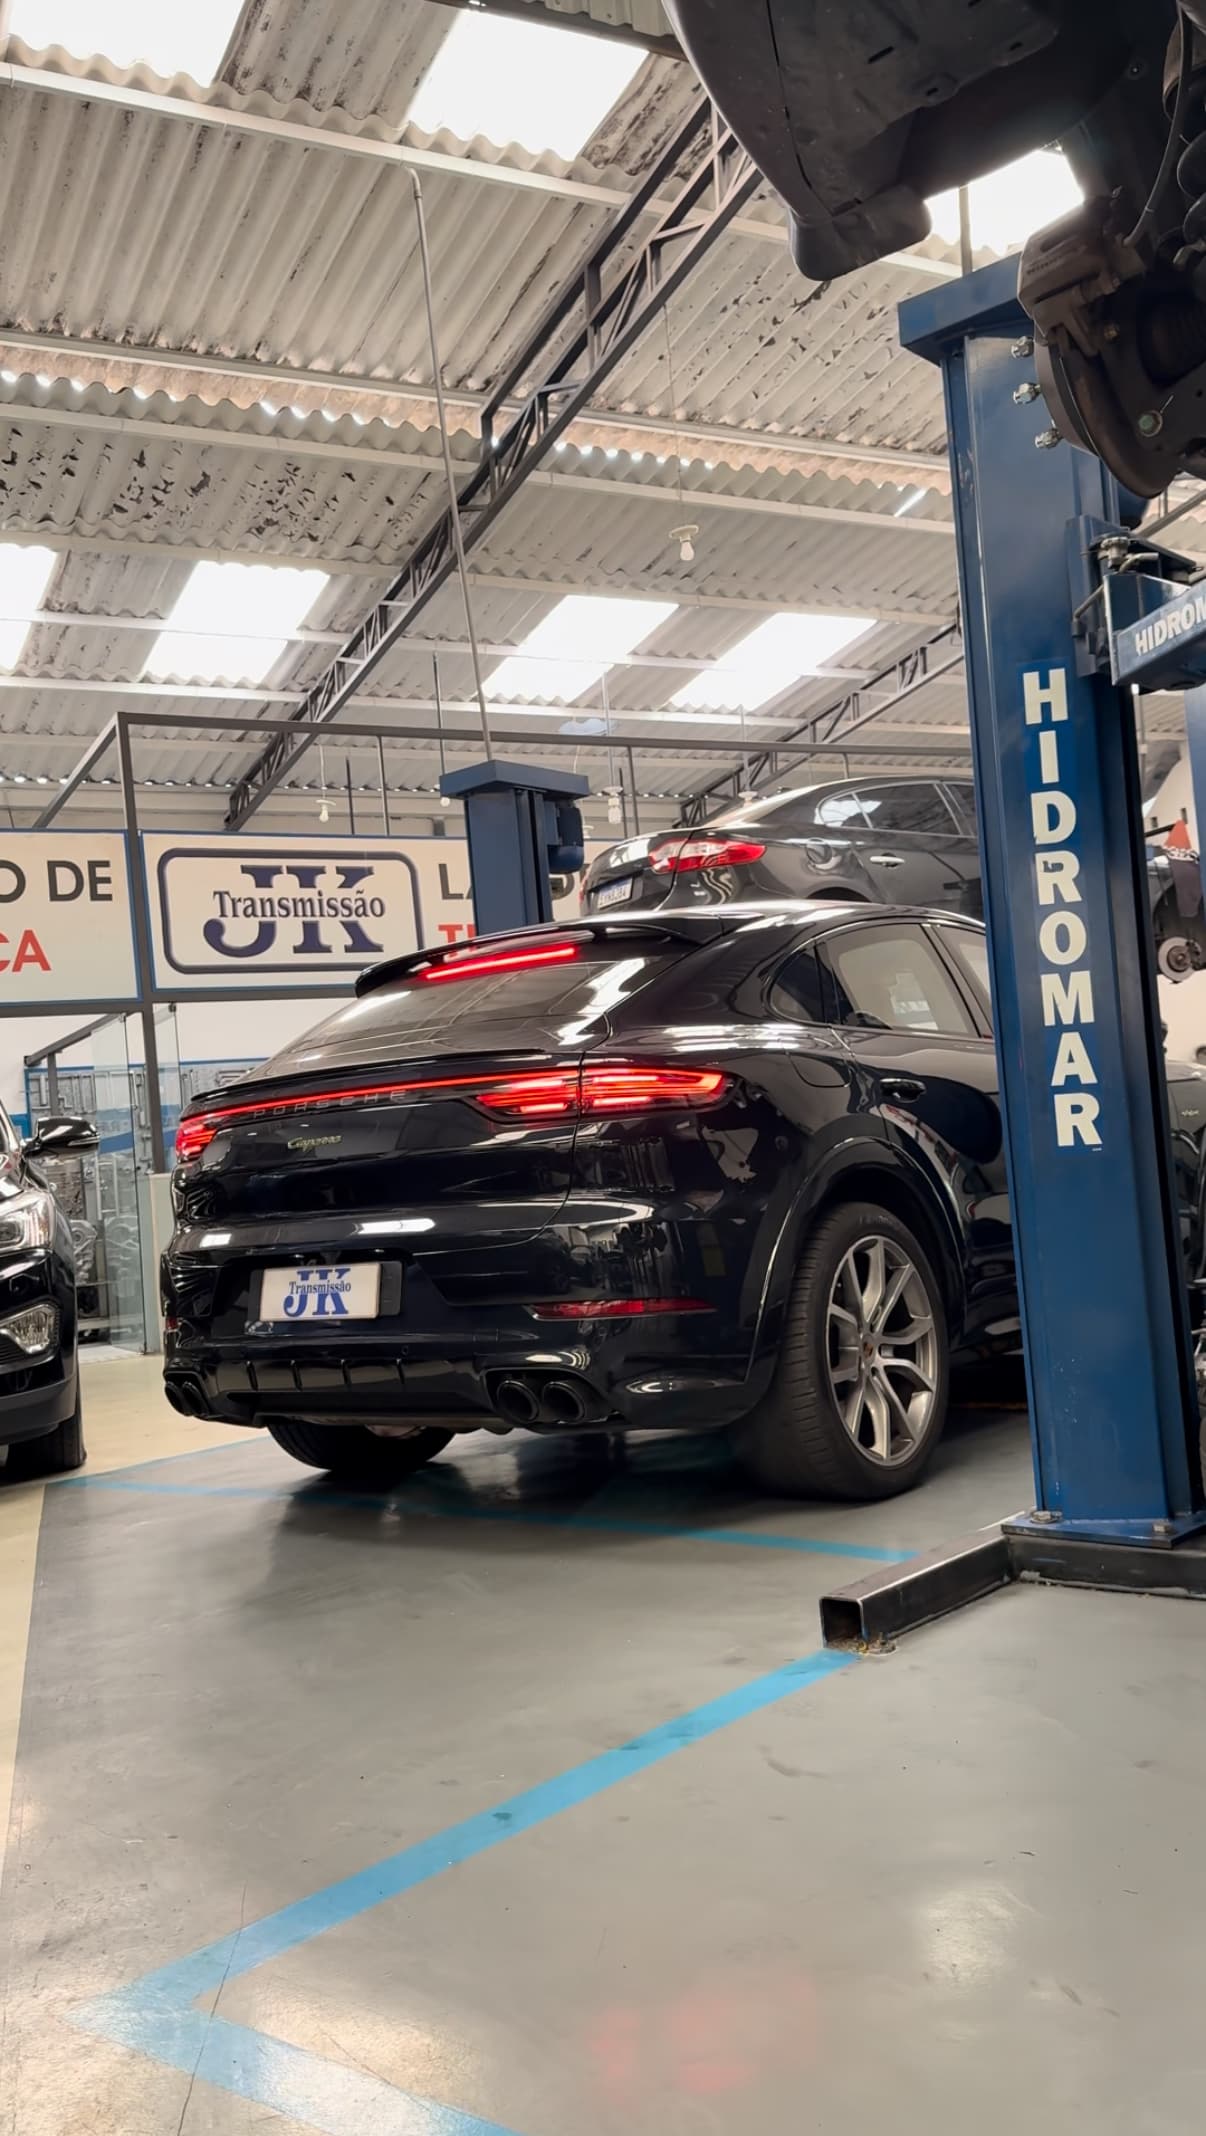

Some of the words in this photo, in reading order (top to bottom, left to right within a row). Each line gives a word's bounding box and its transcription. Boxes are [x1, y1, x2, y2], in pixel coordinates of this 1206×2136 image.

[47, 860, 113, 902] DE
[203, 865, 384, 958] JK
[213, 889, 386, 918] Transmissão
[1023, 668, 1103, 1146] HIDROMAR
[252, 1090, 407, 1119] PORSCHE
[283, 1268, 351, 1318] JK
[289, 1280, 351, 1295] Transmissão
